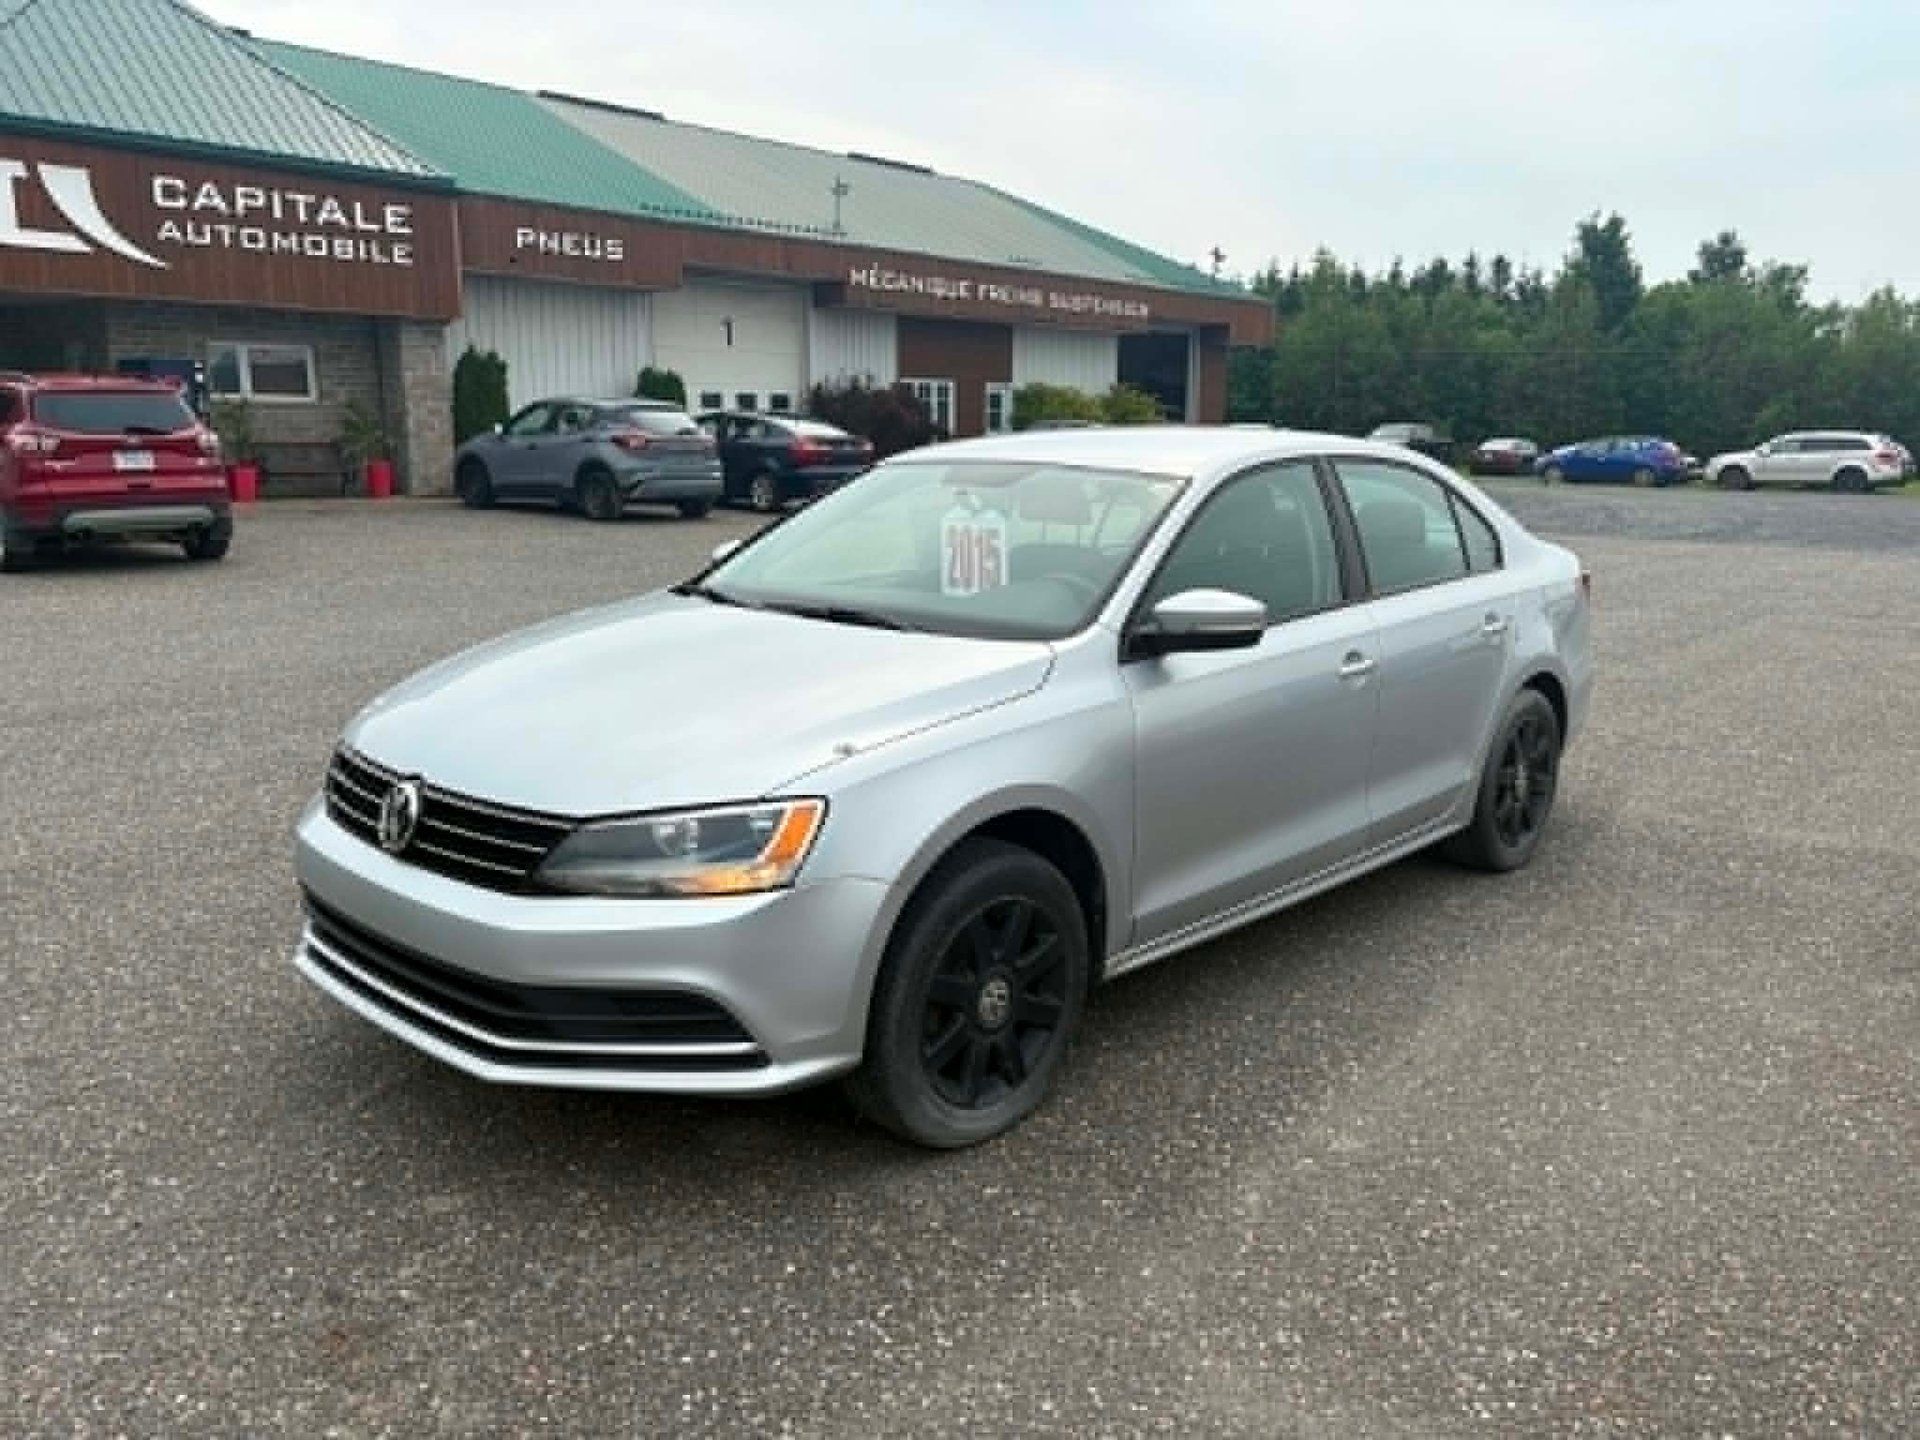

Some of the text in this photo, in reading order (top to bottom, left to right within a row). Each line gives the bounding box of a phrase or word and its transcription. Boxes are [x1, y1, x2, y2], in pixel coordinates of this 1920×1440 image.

[152, 174, 413, 234] CAPITALE
[157, 219, 413, 264] AUTOMOBILE
[516, 226, 624, 261] PNEUS
